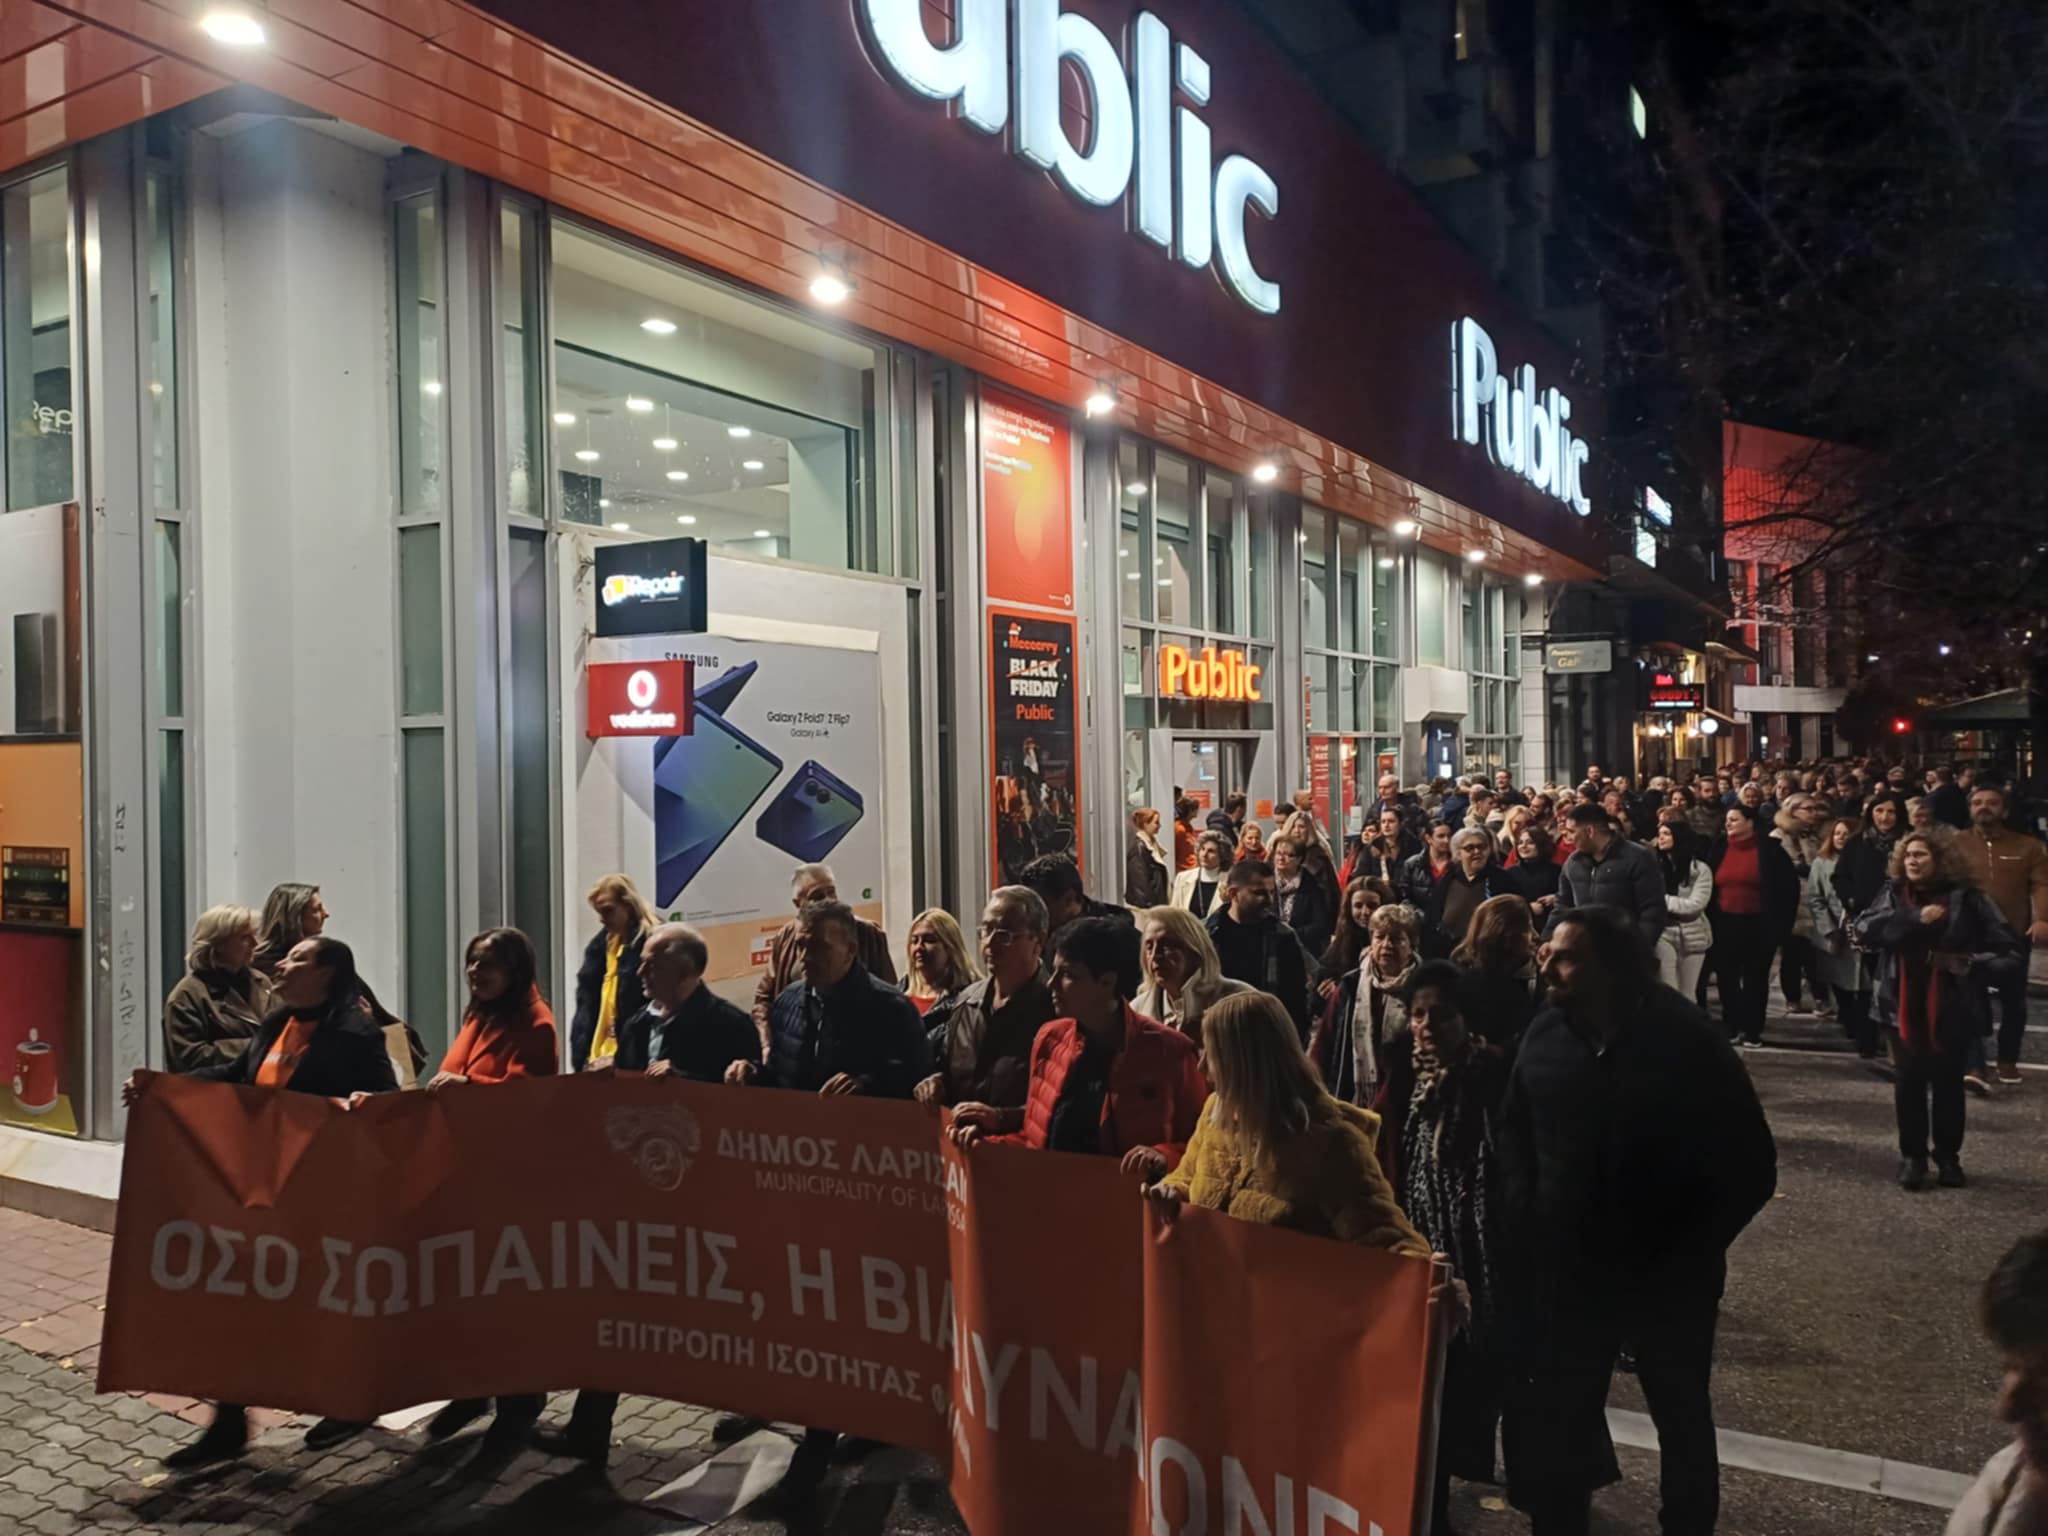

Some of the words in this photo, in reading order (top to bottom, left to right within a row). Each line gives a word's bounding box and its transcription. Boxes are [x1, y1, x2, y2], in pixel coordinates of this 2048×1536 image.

[1455, 316, 1591, 516] Public
[665, 652, 719, 668] SAMSUNG
[1009, 658, 1059, 678] BLACK
[1159, 643, 1262, 701] Public
[1010, 679, 1059, 698] FRIDAY
[609, 710, 677, 729] vodafone
[766, 711, 797, 725] Galaxy
[1015, 703, 1055, 720] Public
[717, 1128, 840, 1170] ΔΗΜΟΣ
[851, 1143, 967, 1208] ΛΑΡΙΣΑΙ
[755, 1170, 884, 1204] MUNICIPALITY
[891, 1187, 915, 1209] OF
[151, 1219, 299, 1301] ΟΣΟ
[318, 1219, 766, 1321] ΣΩΠΑΙΝΕΙΣ,
[787, 1243, 838, 1321] Η
[597, 1319, 754, 1368] ΕΠΙΤΡΟΠΗ
[767, 1341, 923, 1404] ΙΣΟΤΗΤΑΣ
